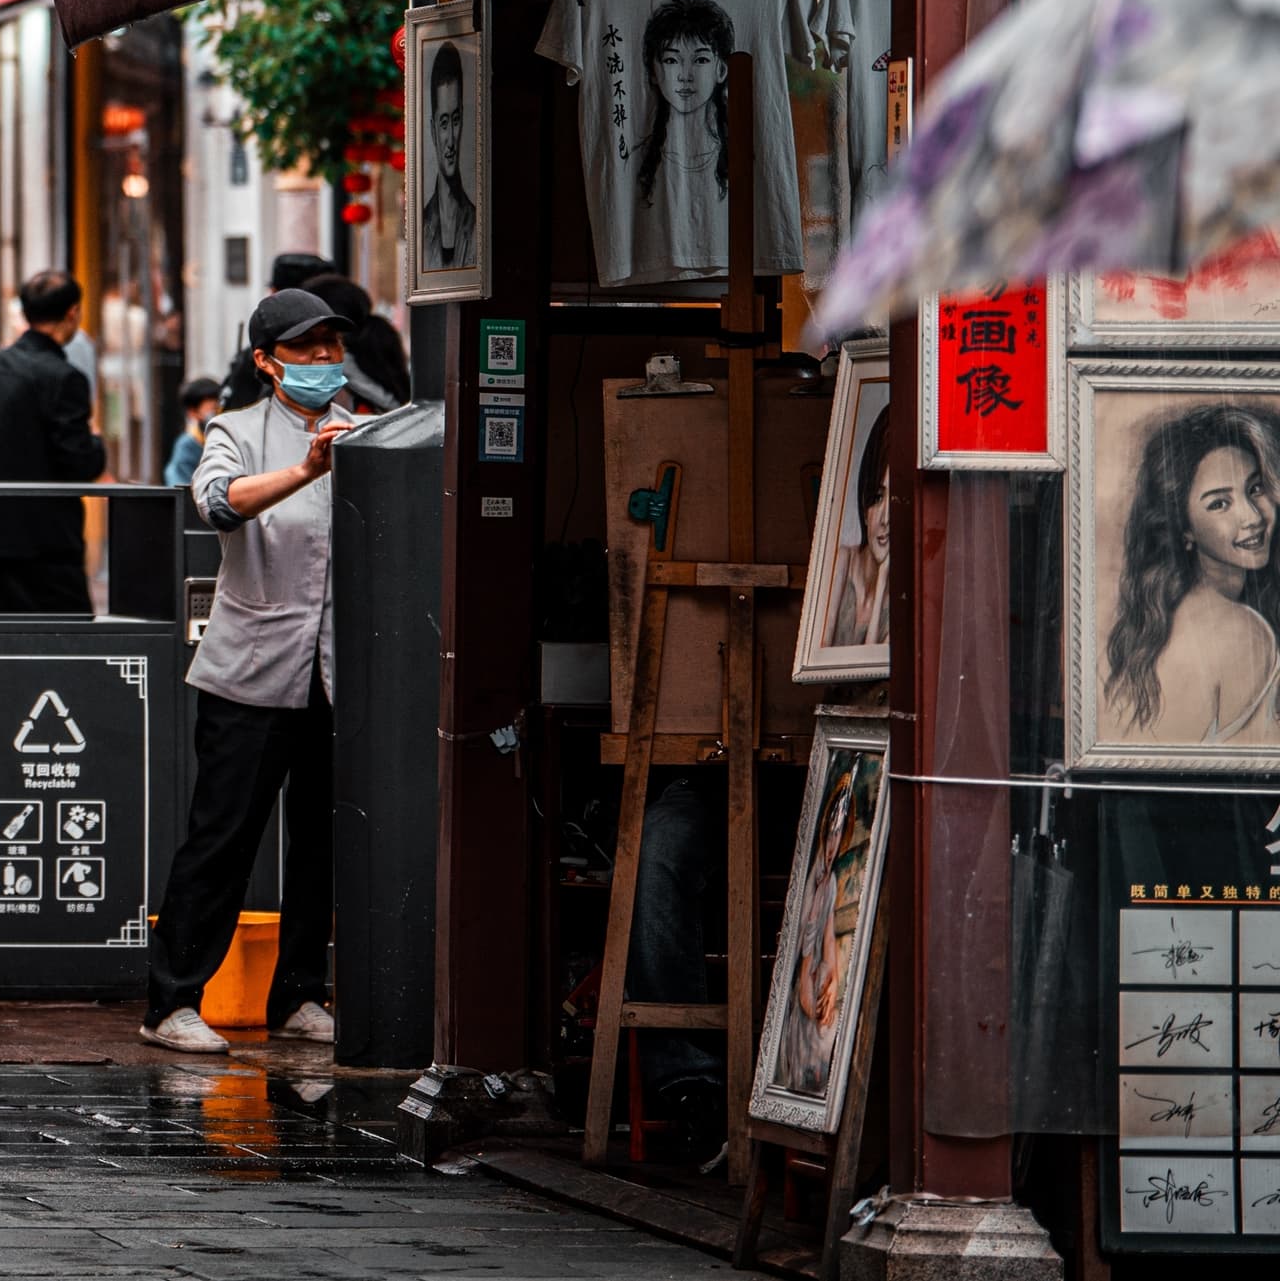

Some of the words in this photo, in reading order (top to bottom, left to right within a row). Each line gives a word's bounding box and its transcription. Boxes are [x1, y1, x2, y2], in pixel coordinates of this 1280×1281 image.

[601, 23, 630, 161] 水洗不掉色
[20, 762, 81, 778] 可回收物
[23, 778, 77, 791] Recyclable
[1130, 883, 1280, 901] 既简单又独特的
